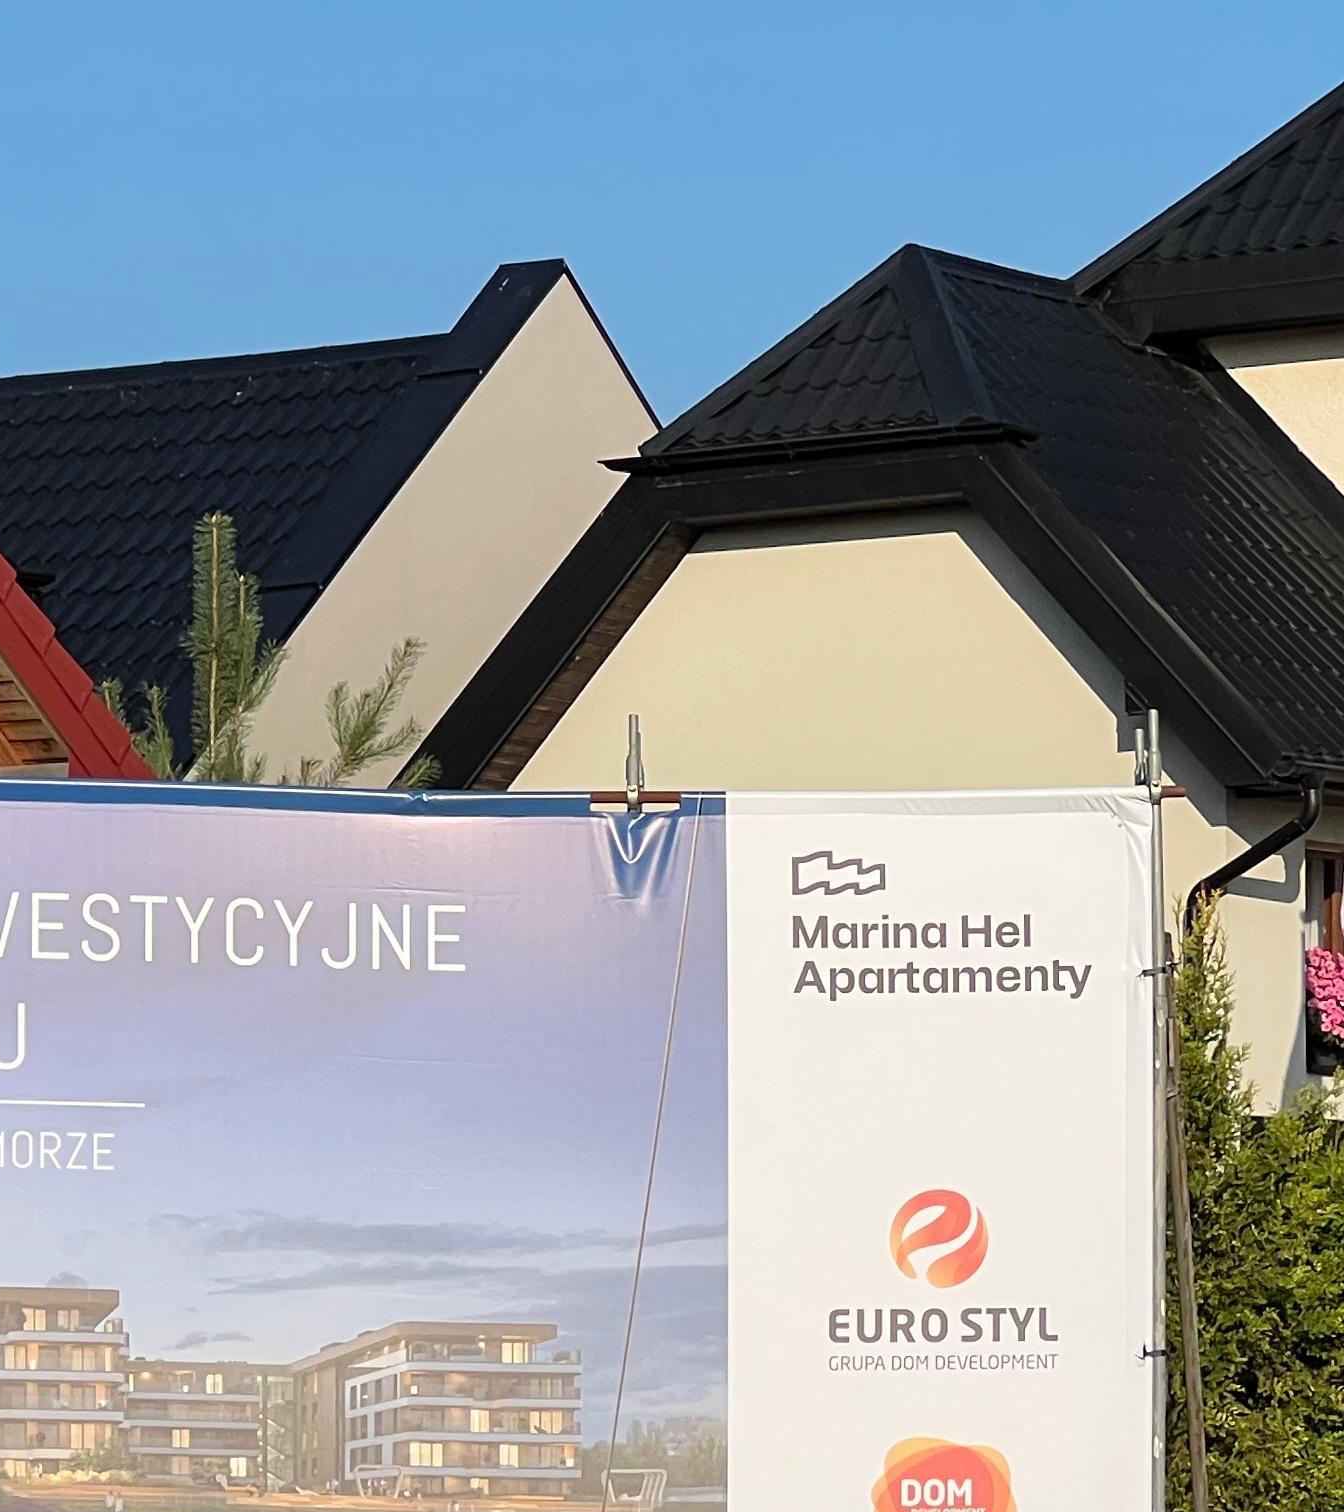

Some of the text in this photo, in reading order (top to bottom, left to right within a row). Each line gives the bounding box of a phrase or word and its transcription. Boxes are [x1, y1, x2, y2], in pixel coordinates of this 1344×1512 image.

[792, 914, 1032, 949] Marina Hel
[792, 959, 1092, 1001] Apartamenty
[828, 1307, 1058, 1343] EURO STYL
[828, 1353, 1058, 1371] GRUPA DOM DEVELOPMENT
[901, 1478, 973, 1507] DOM
